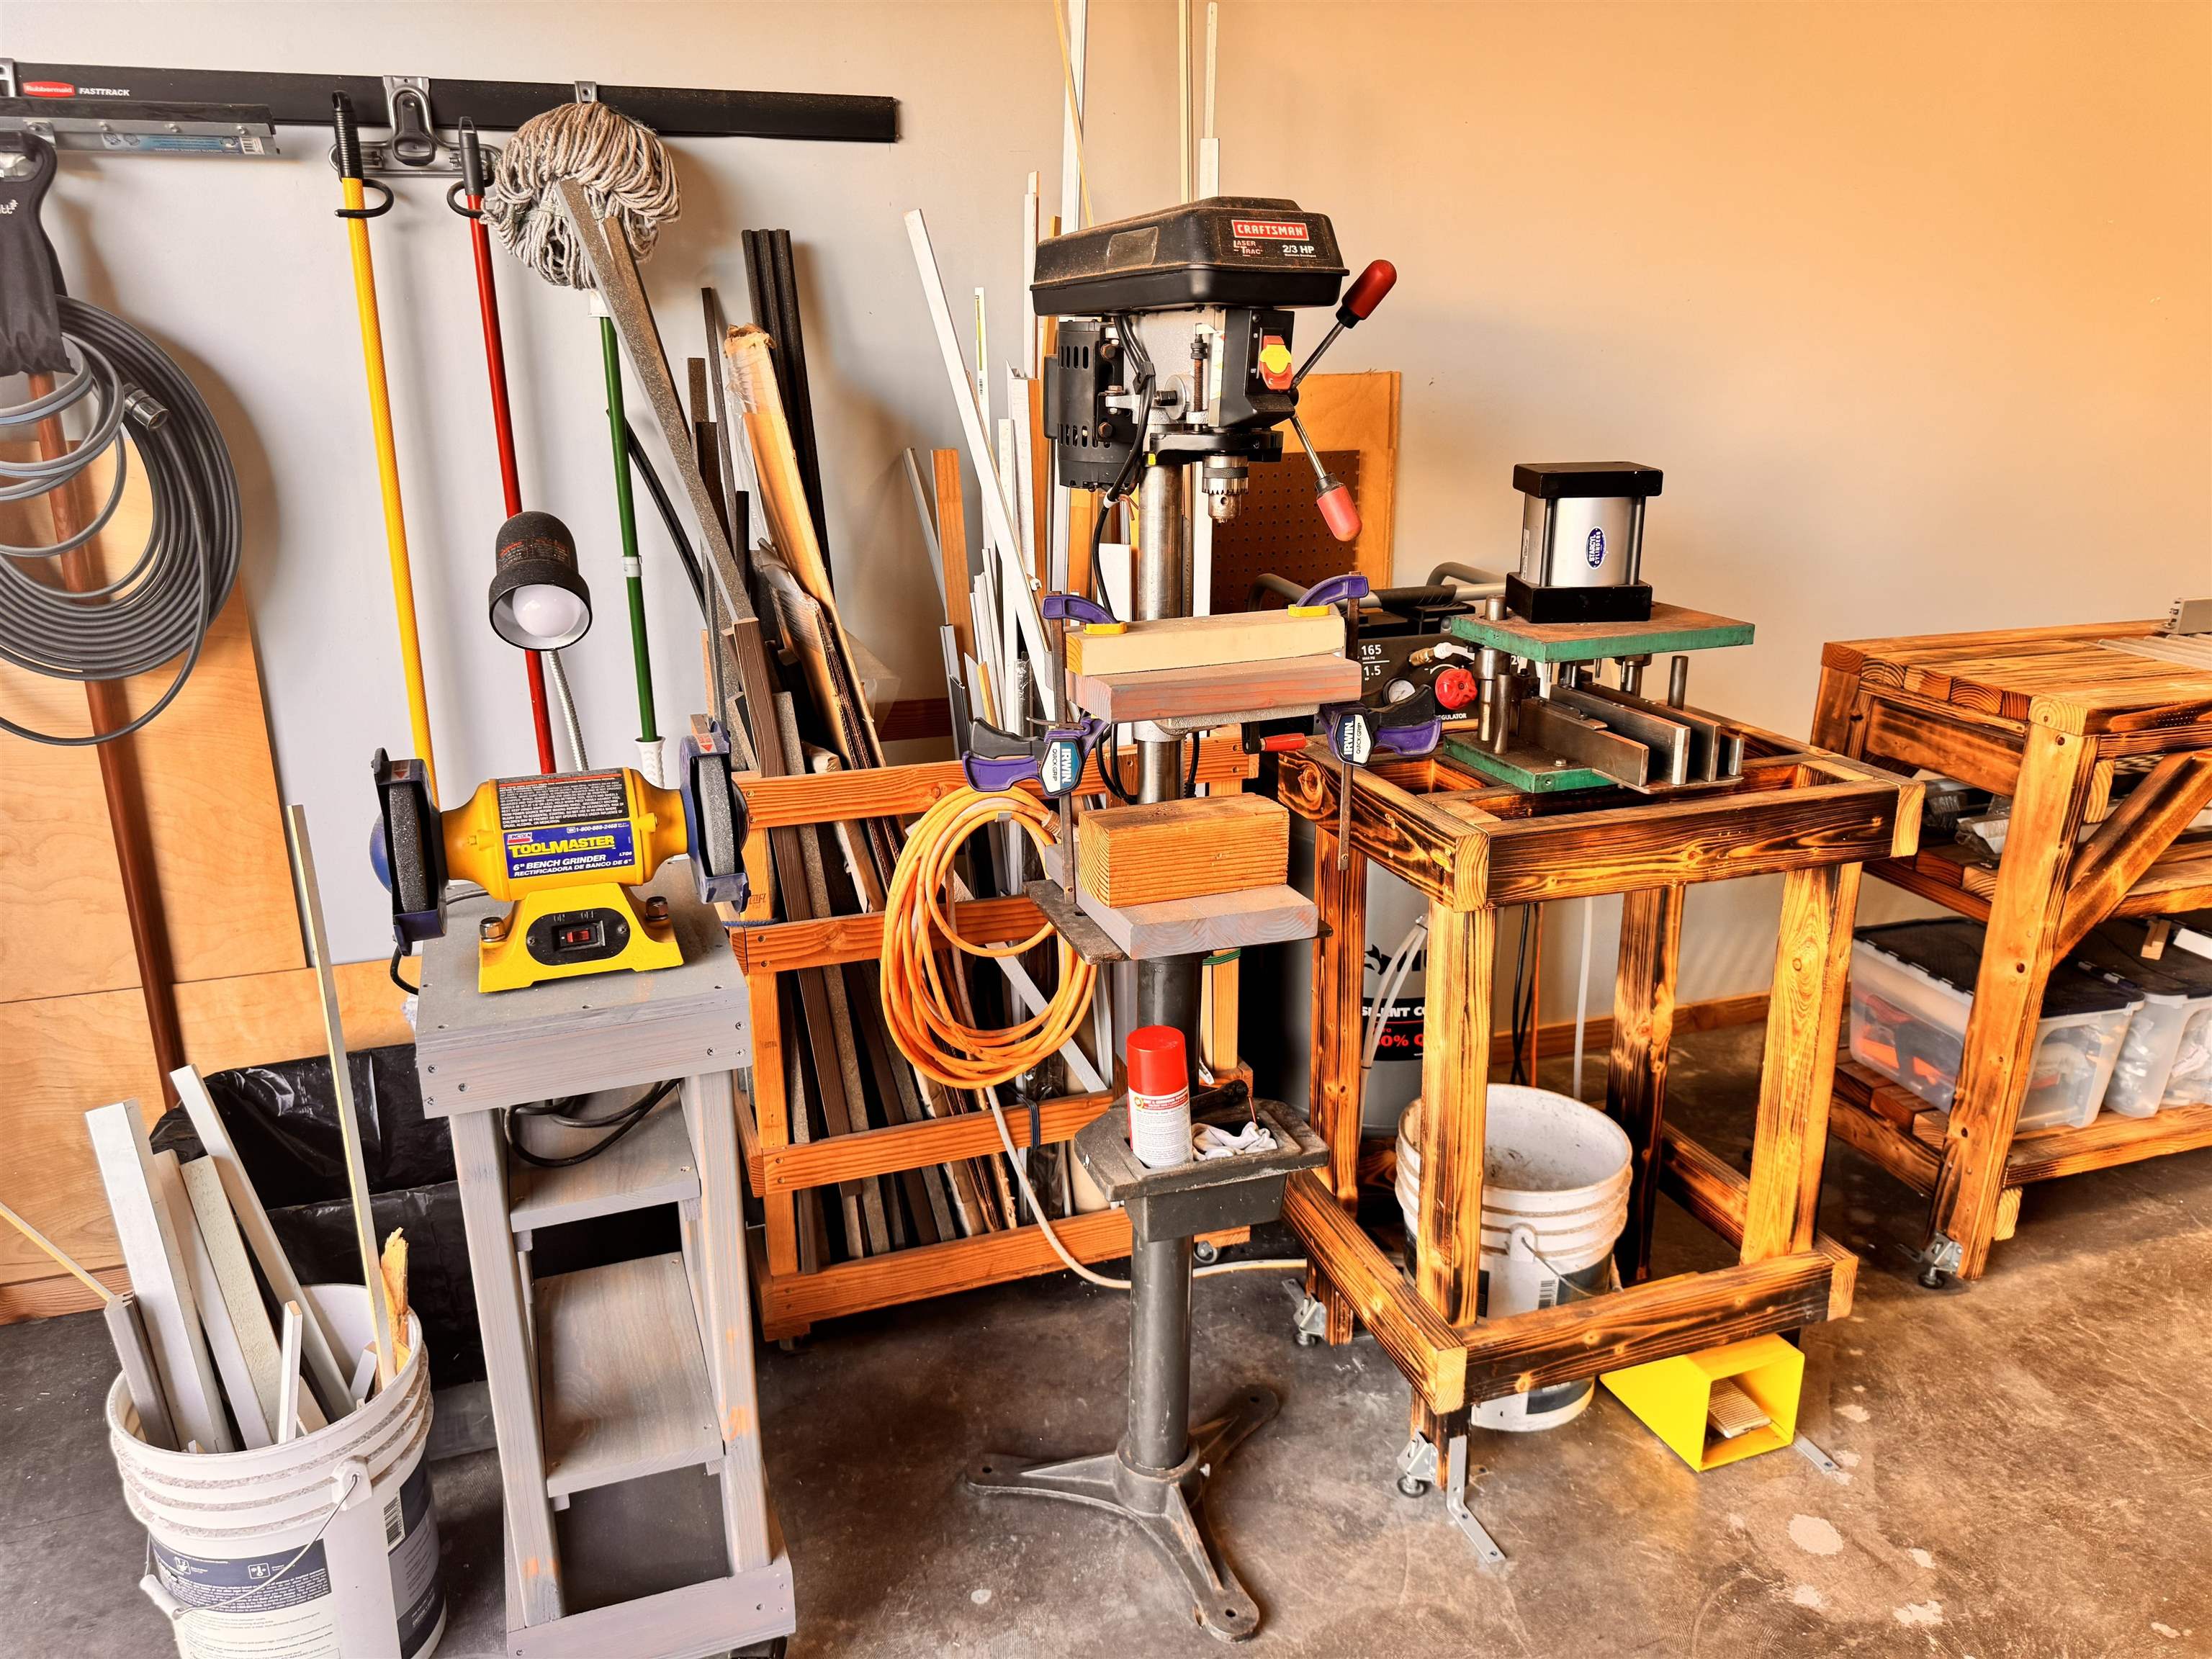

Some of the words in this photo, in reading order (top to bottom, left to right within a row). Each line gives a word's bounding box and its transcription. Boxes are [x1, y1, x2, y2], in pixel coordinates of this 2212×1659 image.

[79, 87, 130, 96] FASTTRACK
[1237, 224, 1303, 236] CRAFTSMAN
[1233, 240, 1256, 248] LASER
[1282, 245, 1298, 253] 2/3
[1300, 245, 1315, 253] HP
[1241, 246, 1262, 254] TRAC
[1362, 644, 1382, 655] 165
[1364, 665, 1381, 676] 1.5
[1344, 721, 1354, 755] IRWIN
[1062, 748, 1071, 783] IRWIN
[526, 859, 561, 870] BENCH
[562, 854, 606, 865] GRINDER
[514, 866, 572, 877] RECTIFICADORA
[1378, 1034, 1409, 1047] 0%
